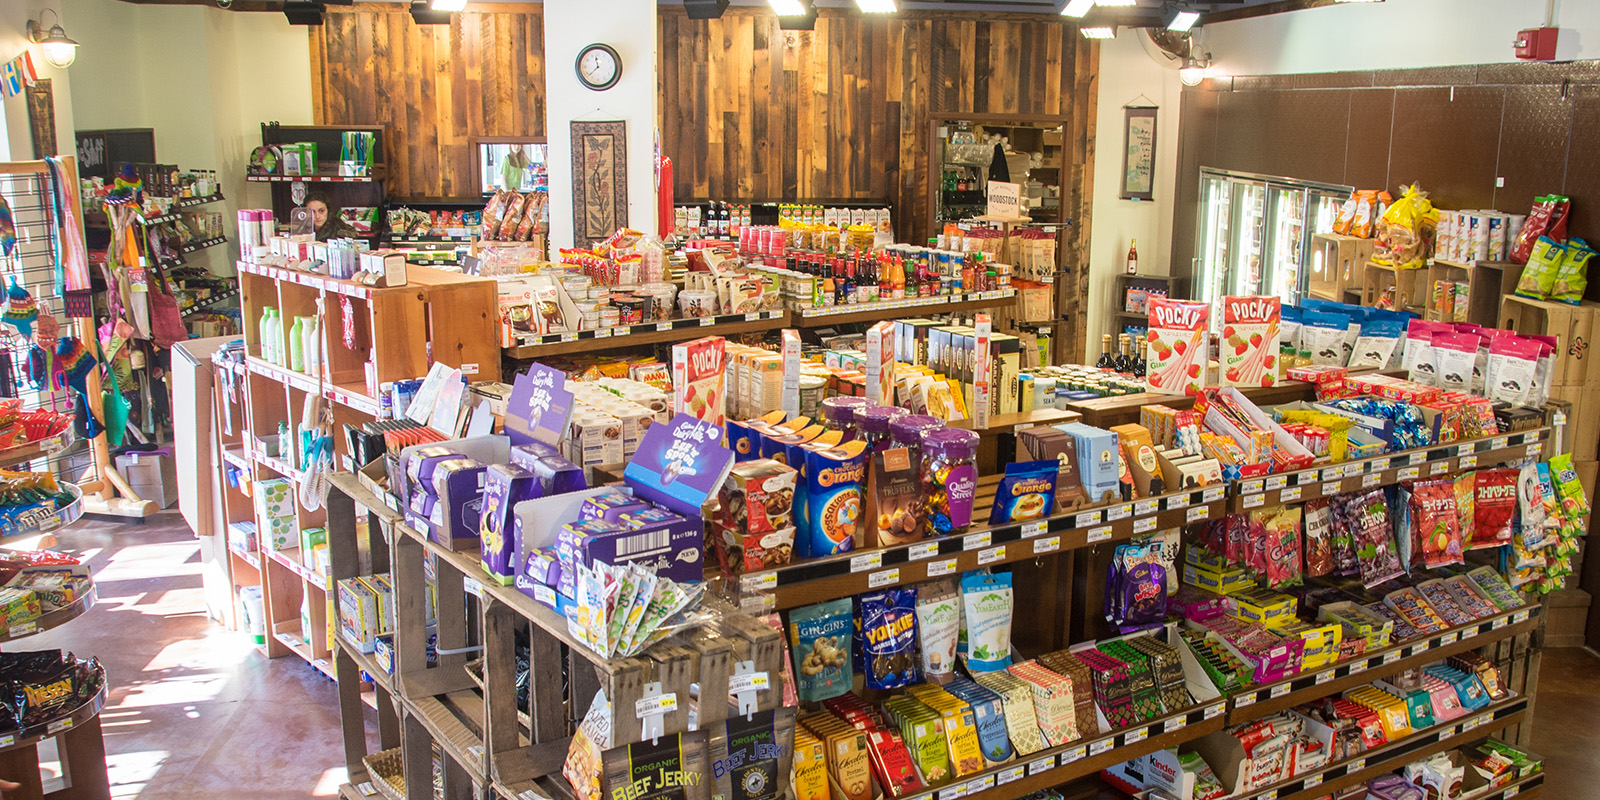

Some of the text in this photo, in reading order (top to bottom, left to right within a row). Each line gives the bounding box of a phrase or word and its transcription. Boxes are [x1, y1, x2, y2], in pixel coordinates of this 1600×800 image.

[989, 194, 1017, 205] WOODSTOCK
[1155, 306, 1201, 328] POCKY
[1231, 299, 1275, 322] POCKY
[692, 345, 722, 377] POCKY
[664, 446, 696, 468] Spoon
[882, 485, 916, 497] TRUFFLES
[949, 481, 975, 493] Quality
[951, 490, 973, 500] Street
[1012, 482, 1052, 496] Orange
[680, 549, 697, 558] NEW
[801, 620, 845, 638] GIN GINS
[865, 612, 914, 645] YORKIE
[23, 677, 73, 708] RIESEN
[978, 715, 1004, 733] Chocolove
[731, 734, 770, 752] ORGANIC
[918, 735, 946, 752] Chocolove
[950, 728, 977, 746] Chocolove
[633, 758, 679, 774] ORGANIC
[712, 744, 791, 782] BEEF JERKY
[795, 760, 826, 779] Chocolove
[839, 751, 868, 770] Chocolove
[1149, 755, 1177, 777] kinder
[611, 768, 703, 800] BEEF JERKY
